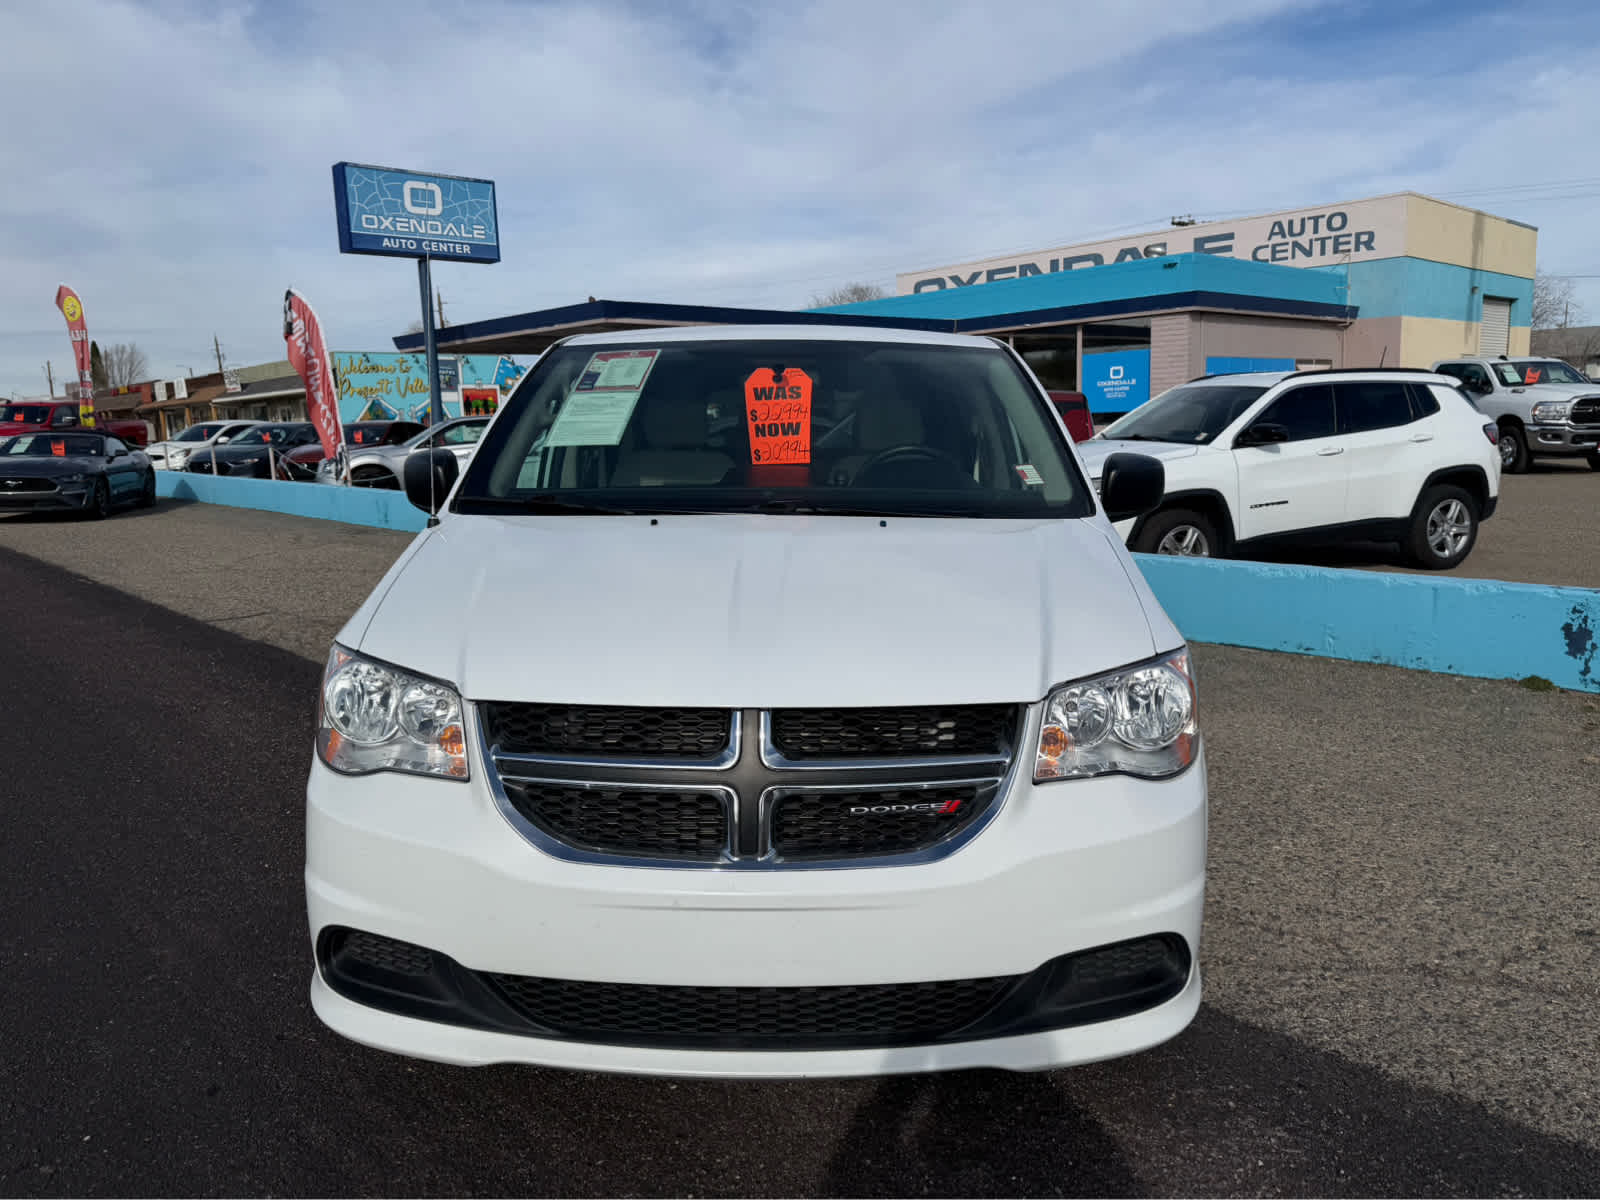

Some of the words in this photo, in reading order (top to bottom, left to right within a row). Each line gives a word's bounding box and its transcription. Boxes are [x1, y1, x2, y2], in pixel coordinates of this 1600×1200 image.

[361, 214, 486, 239] OXENDALE
[1268, 211, 1348, 241] AUTO
[382, 238, 417, 250] AUTO
[422, 241, 471, 254] CENTER
[1251, 230, 1376, 263] CENTER
[914, 232, 1235, 294] OXENDAE
[396, 357, 412, 373] to
[753, 385, 802, 401] WAS
[754, 422, 801, 438] NOW
[850, 803, 948, 814] DODGE
